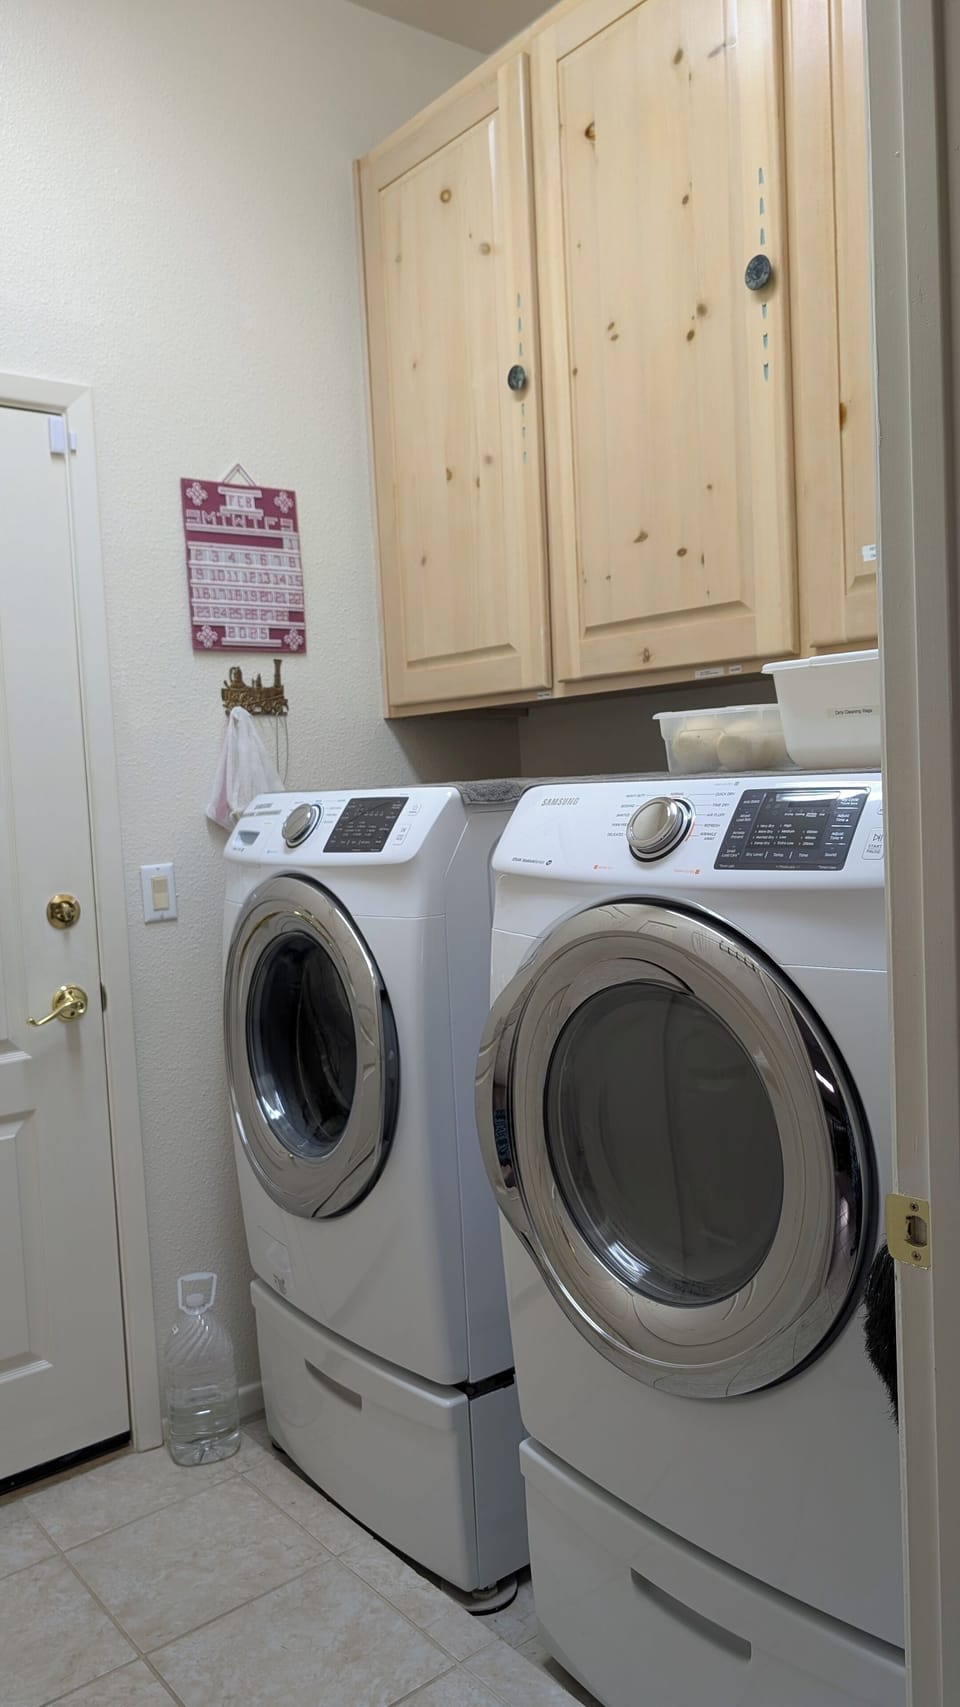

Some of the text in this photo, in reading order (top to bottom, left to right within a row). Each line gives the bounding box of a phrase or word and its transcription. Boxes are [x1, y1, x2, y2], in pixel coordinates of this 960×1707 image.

[212, 570, 225, 581] 10
[227, 571, 238, 582] 11
[244, 572, 256, 583] 12
[259, 573, 271, 584] 13
[274, 574, 286, 585] 14
[289, 575, 302, 586] 15
[196, 588, 210, 599] 16
[228, 590, 242, 601] 18
[243, 591, 257, 602] 19
[259, 592, 272, 602] 20
[275, 592, 287, 602] 21
[288, 594, 302, 604] 22
[196, 607, 210, 618] 23
[212, 608, 227, 618] 24
[229, 608, 243, 619] 25
[228, 627, 268, 639] 2025
[541, 797, 580, 806] SAMSUNG
